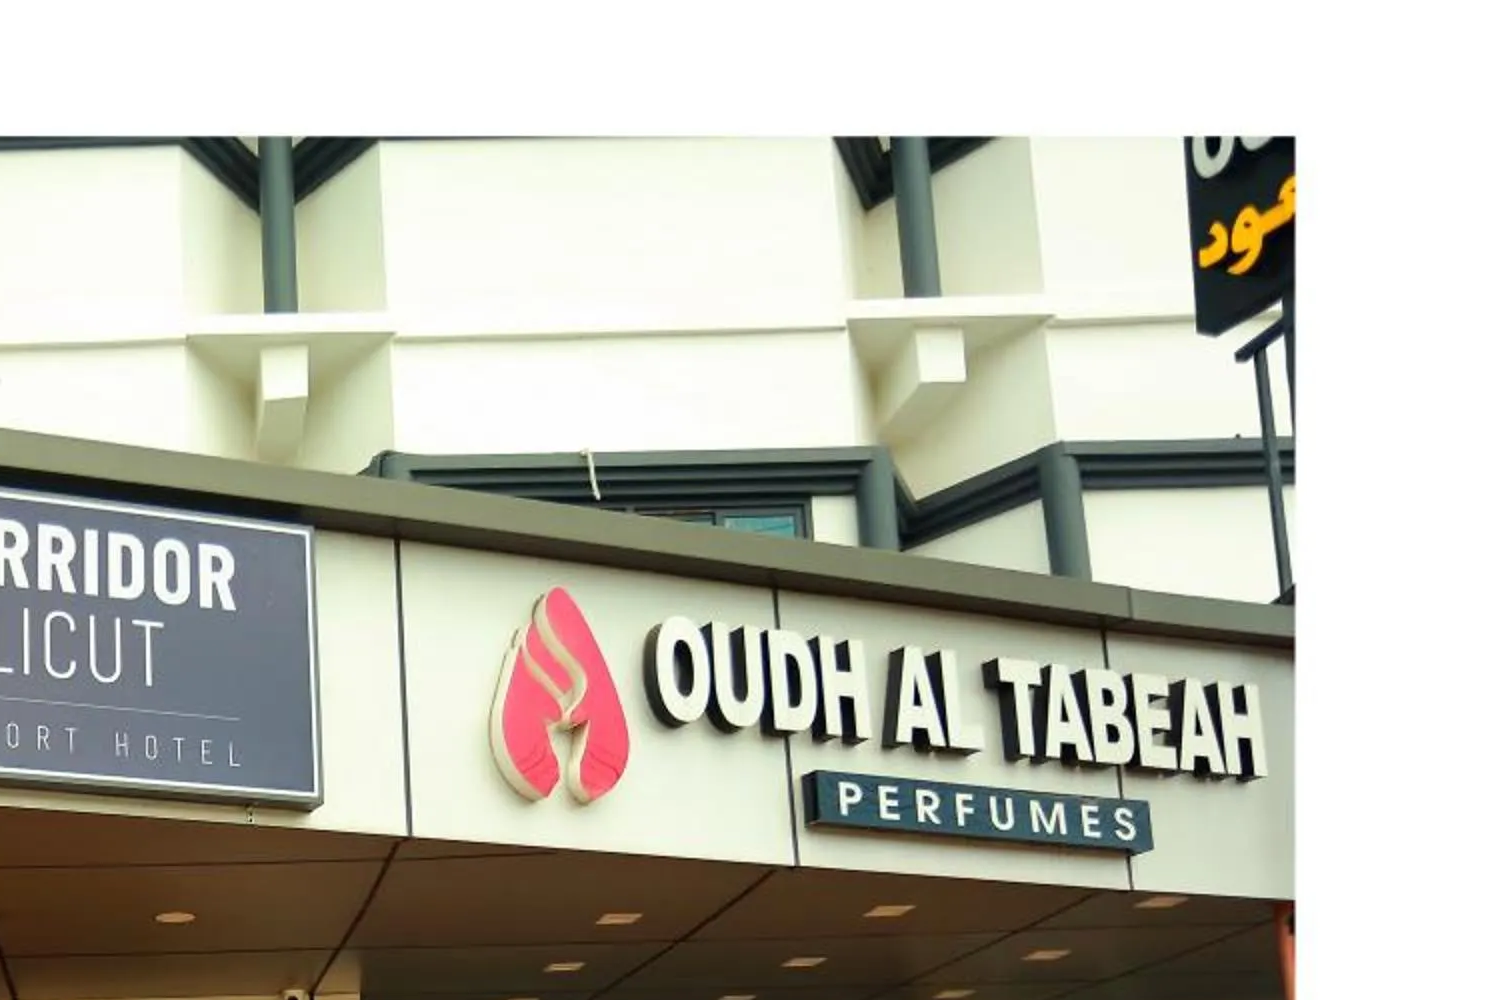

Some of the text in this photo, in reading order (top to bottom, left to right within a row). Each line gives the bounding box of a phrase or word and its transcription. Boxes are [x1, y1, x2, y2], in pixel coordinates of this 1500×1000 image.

[648, 615, 1268, 780] OUDH AL TABEAH
[114, 731, 242, 767] HOTEL
[837, 780, 1138, 843] PERFUMES
